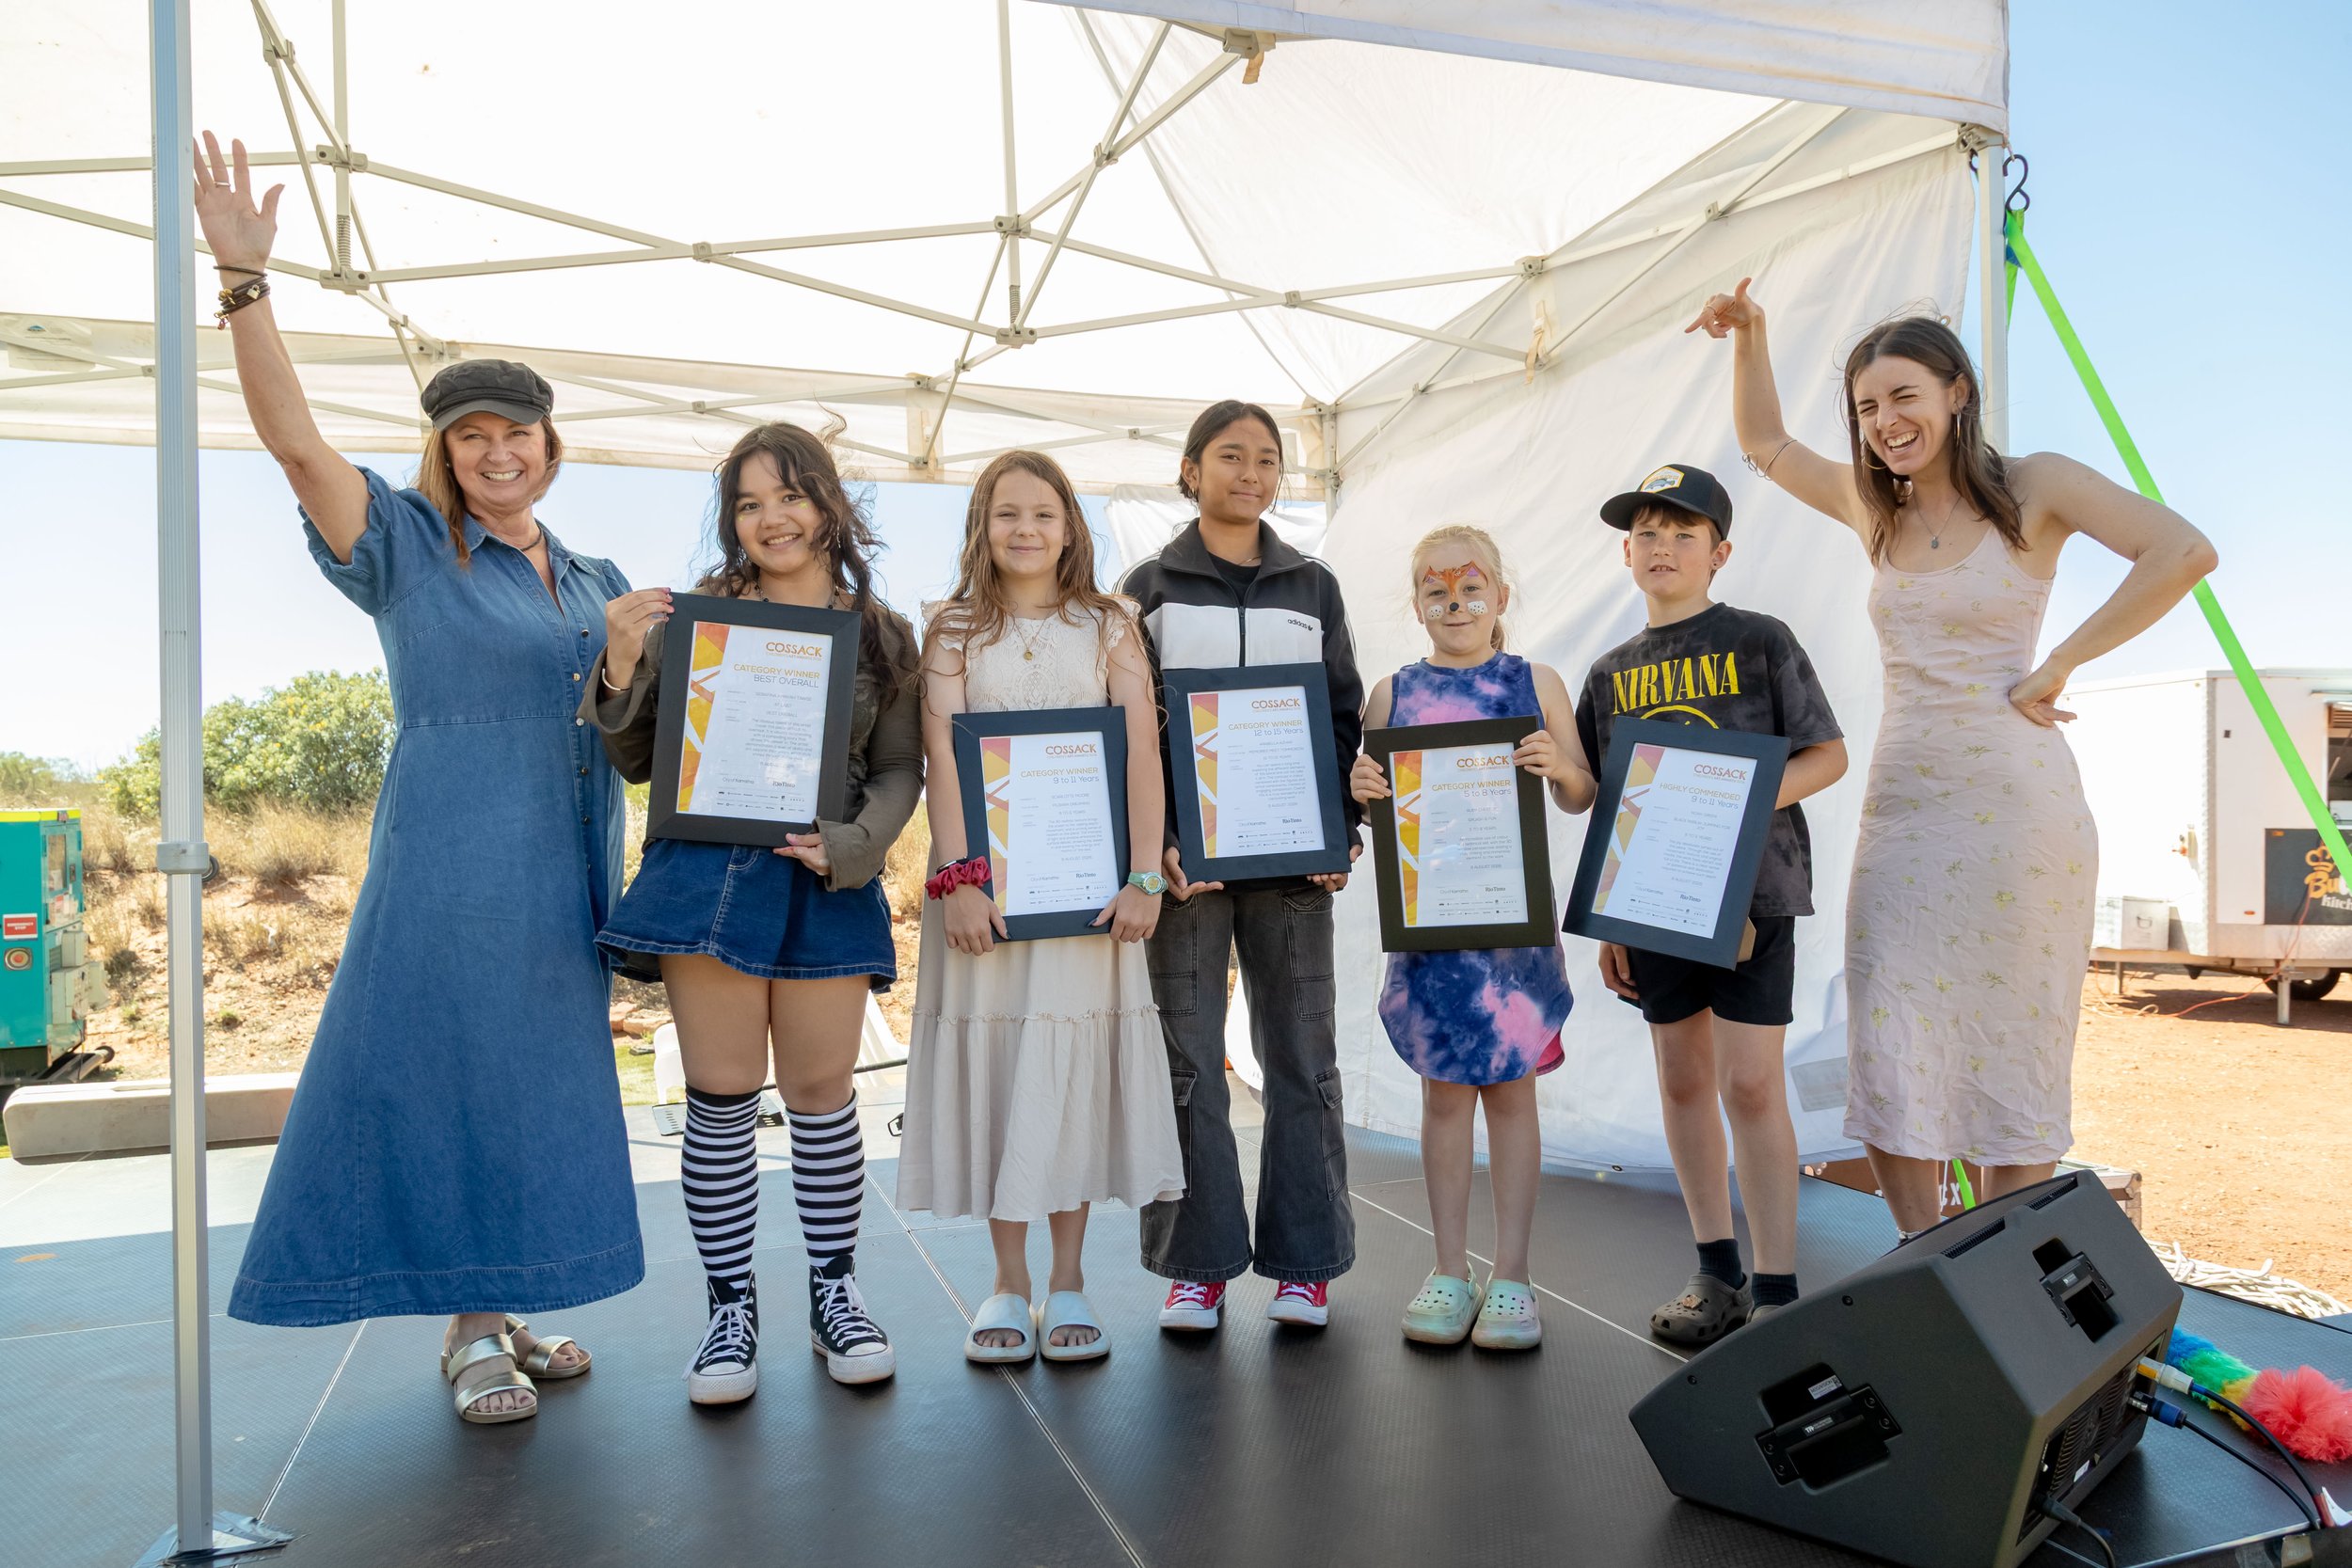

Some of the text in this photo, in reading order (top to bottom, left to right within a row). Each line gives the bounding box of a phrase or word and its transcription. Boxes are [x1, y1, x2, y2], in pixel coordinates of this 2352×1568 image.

[1287, 618, 1308, 629] adidas
[766, 641, 822, 657] COSSACK
[734, 664, 820, 679] CATEGORY WINNER
[754, 674, 819, 688] BEST OVERALL
[1612, 652, 1741, 715] NIRVANA
[1251, 698, 1300, 709] COSSACK
[1228, 721, 1270, 731] CATEGORY
[1046, 744, 1096, 755] COSSACK
[1456, 755, 1509, 768] COSSACK
[1021, 767, 1099, 778] CATEGORY WINNER
[1693, 764, 1747, 780] COSSACK
[1432, 779, 1511, 792] CATEGORY WINNER
[1490, 787, 1512, 796] Years
[1659, 783, 1741, 801] HIGHLY COMMENDED
[1717, 800, 1740, 810] Years
